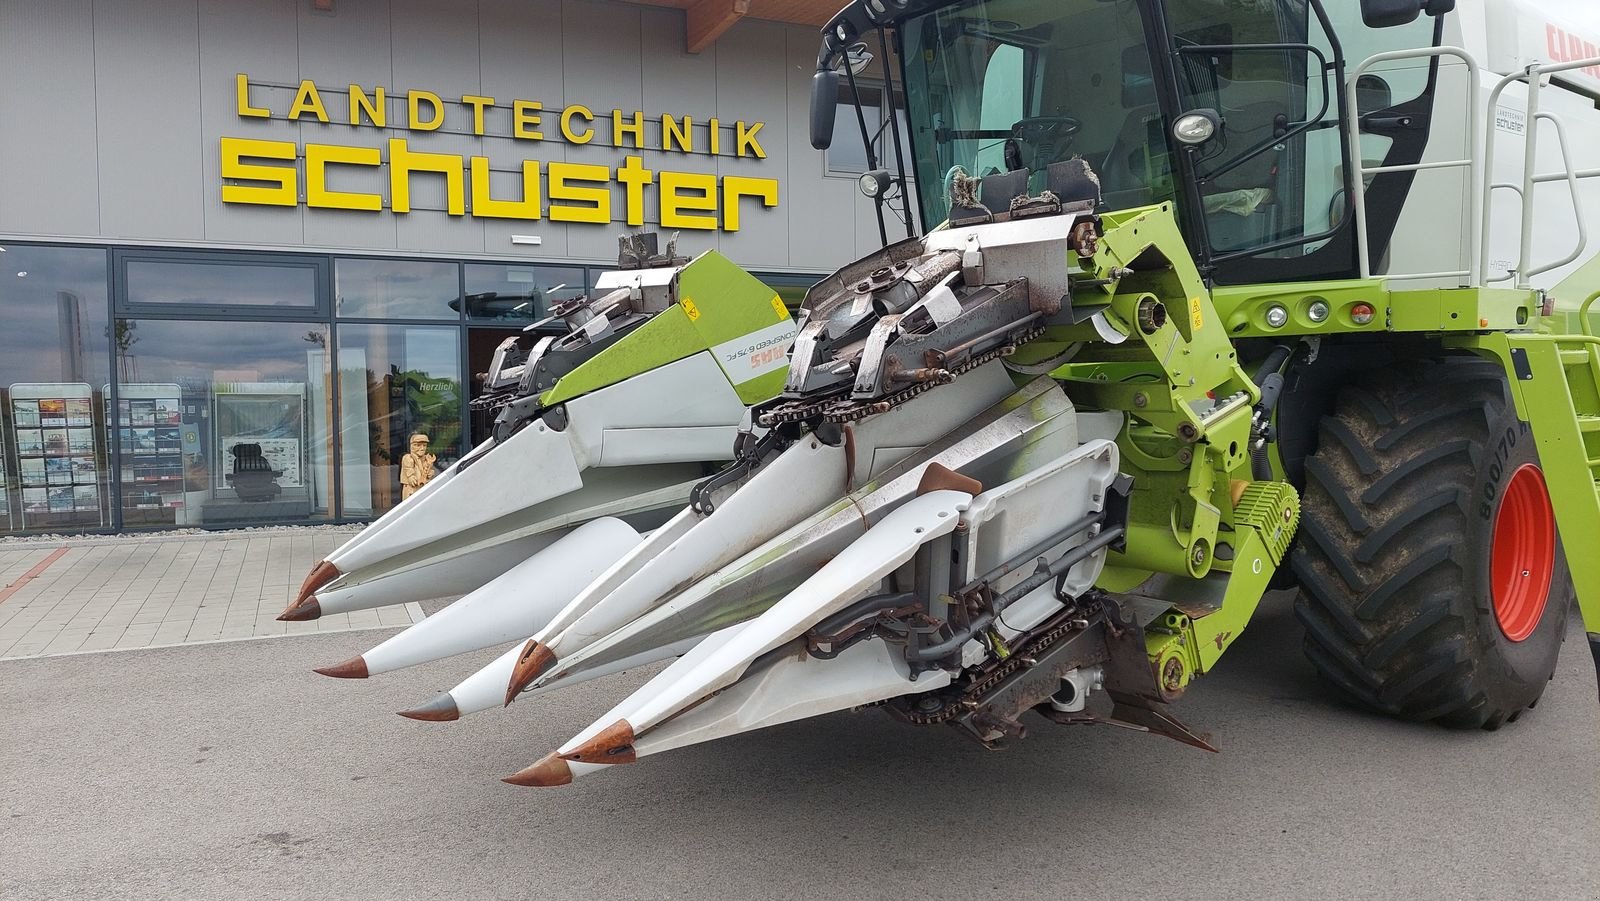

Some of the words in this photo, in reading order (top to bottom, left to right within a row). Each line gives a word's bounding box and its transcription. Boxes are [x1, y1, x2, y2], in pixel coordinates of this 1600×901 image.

[1545, 22, 1600, 79] CLAA
[237, 73, 767, 159] LANDTECHNIK
[751, 344, 785, 369] AAS
[756, 330, 796, 351] CONSPEED
[419, 382, 454, 392] Herzlich
[1480, 426, 1516, 520] 800/70
